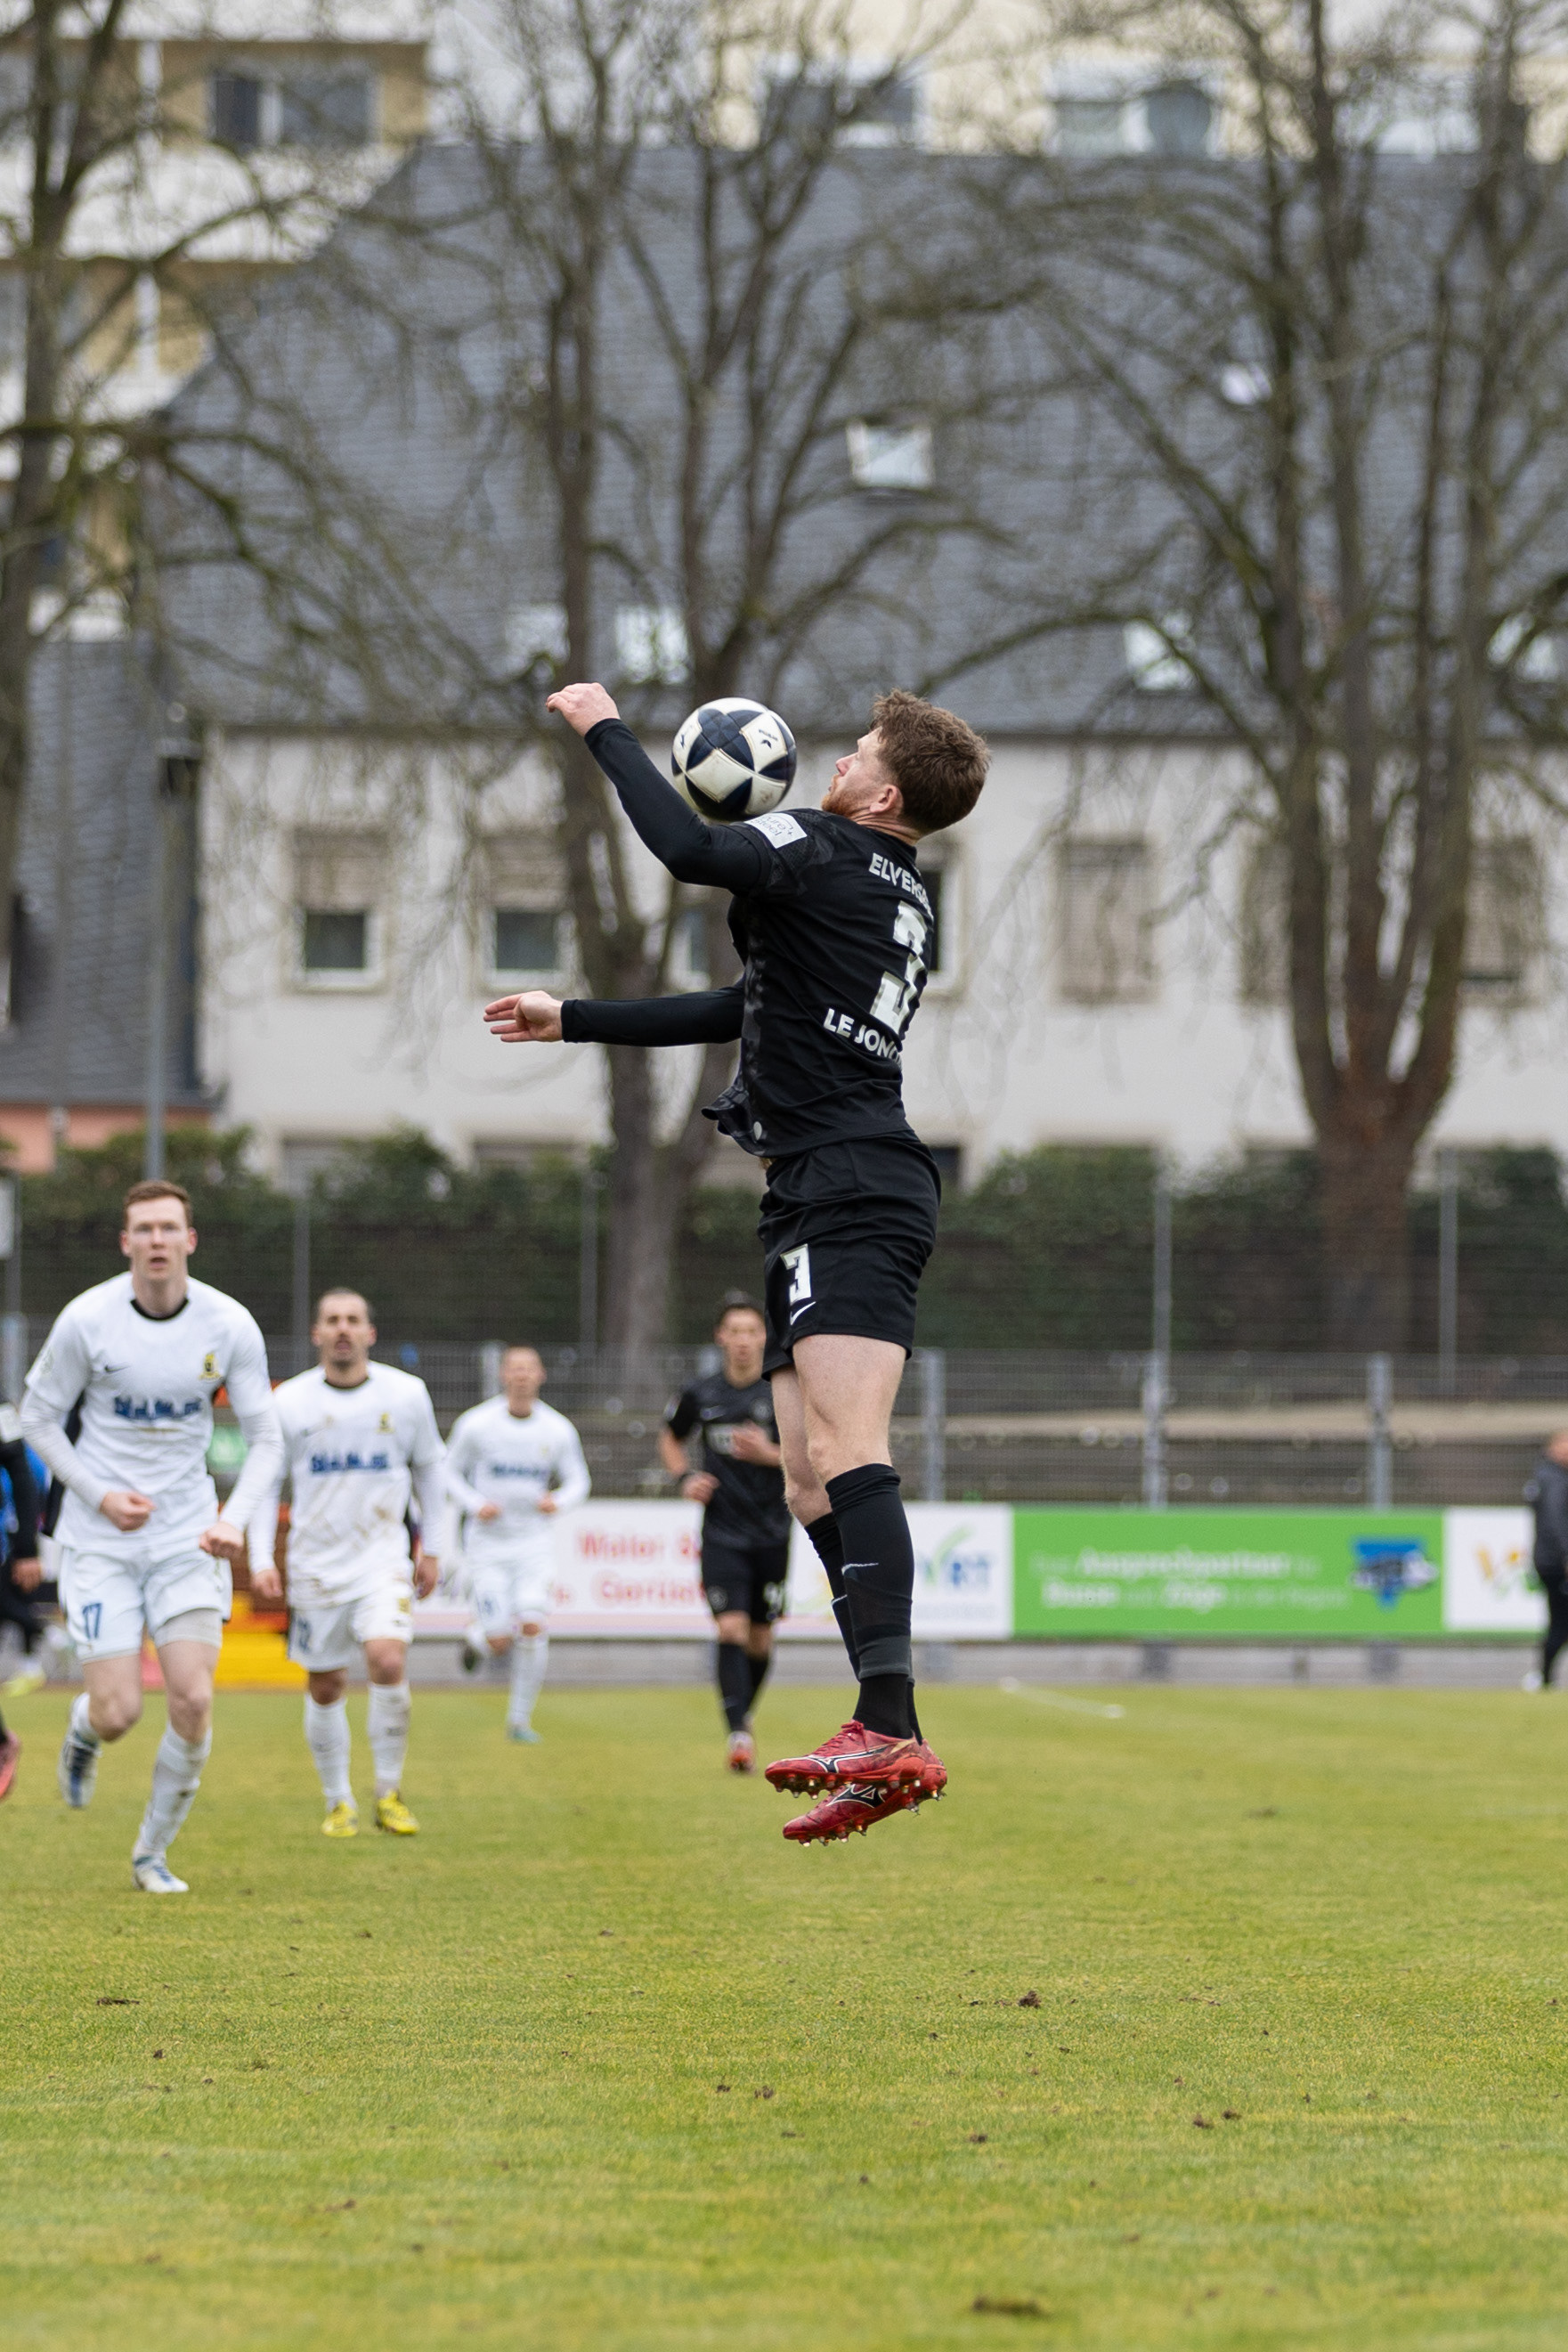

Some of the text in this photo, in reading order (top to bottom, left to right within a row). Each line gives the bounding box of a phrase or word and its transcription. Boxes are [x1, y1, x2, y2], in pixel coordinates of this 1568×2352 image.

[823, 1008, 855, 1038] LE
[780, 1243, 812, 1306] 3
[82, 1602, 102, 1640] 17
